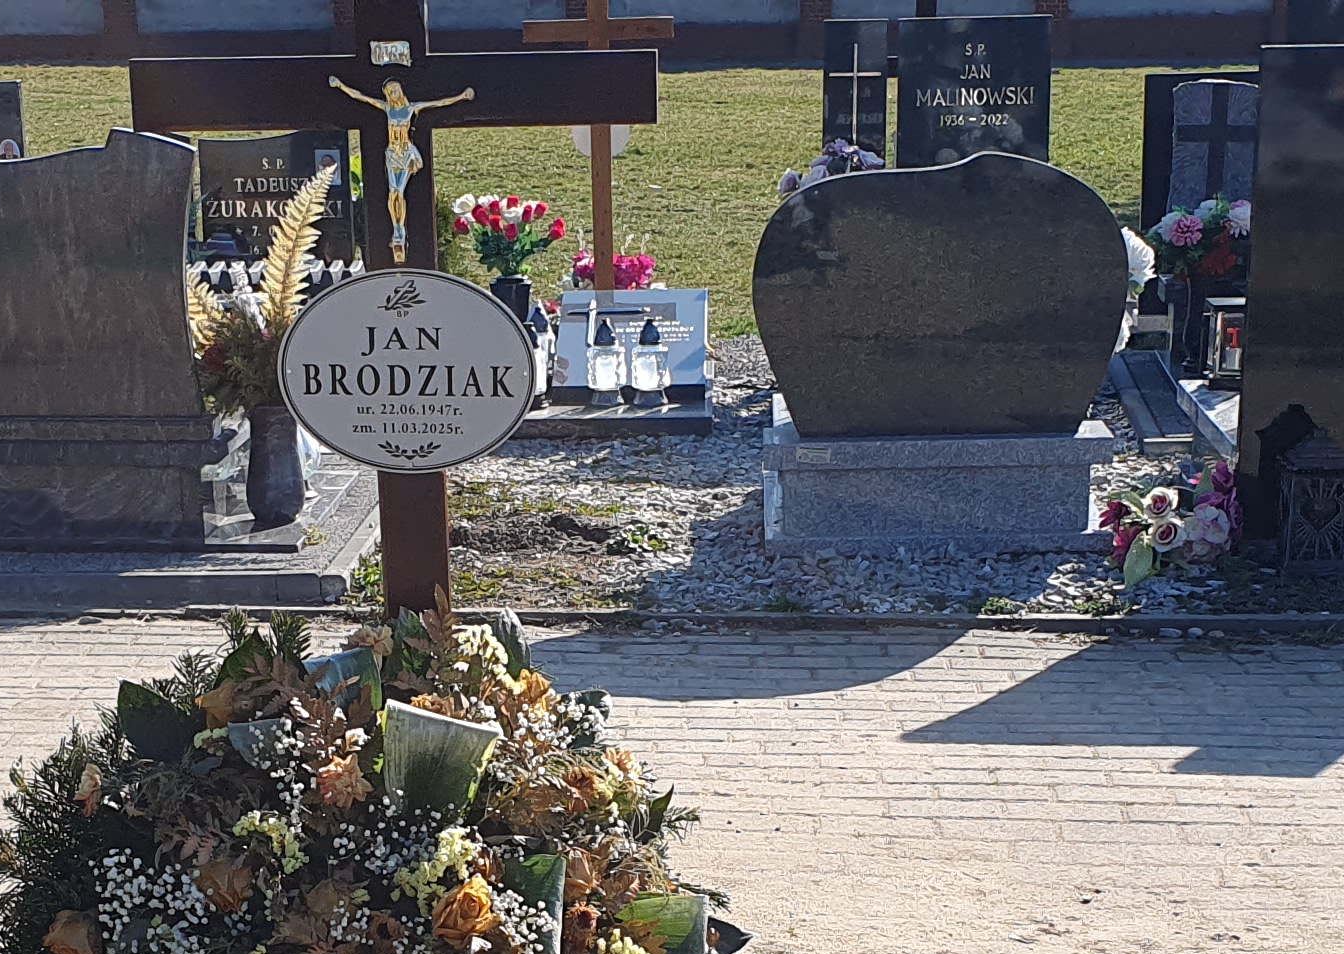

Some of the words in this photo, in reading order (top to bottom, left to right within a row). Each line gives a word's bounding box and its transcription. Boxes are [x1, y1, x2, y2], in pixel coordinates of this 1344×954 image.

[960, 64, 991, 80] JAN
[916, 86, 1034, 107] MALINOWSKI
[940, 114, 965, 126] 1936
[980, 114, 1009, 126] 2022
[207, 198, 343, 218] ŻURAKOKI
[360, 326, 443, 357] JAN
[302, 363, 515, 398] BRODZIAK
[356, 405, 375, 416] ur.
[380, 403, 463, 416] 22.06.1947r.
[352, 424, 376, 435] zm.
[382, 422, 464, 435] 11.03.2025r.
